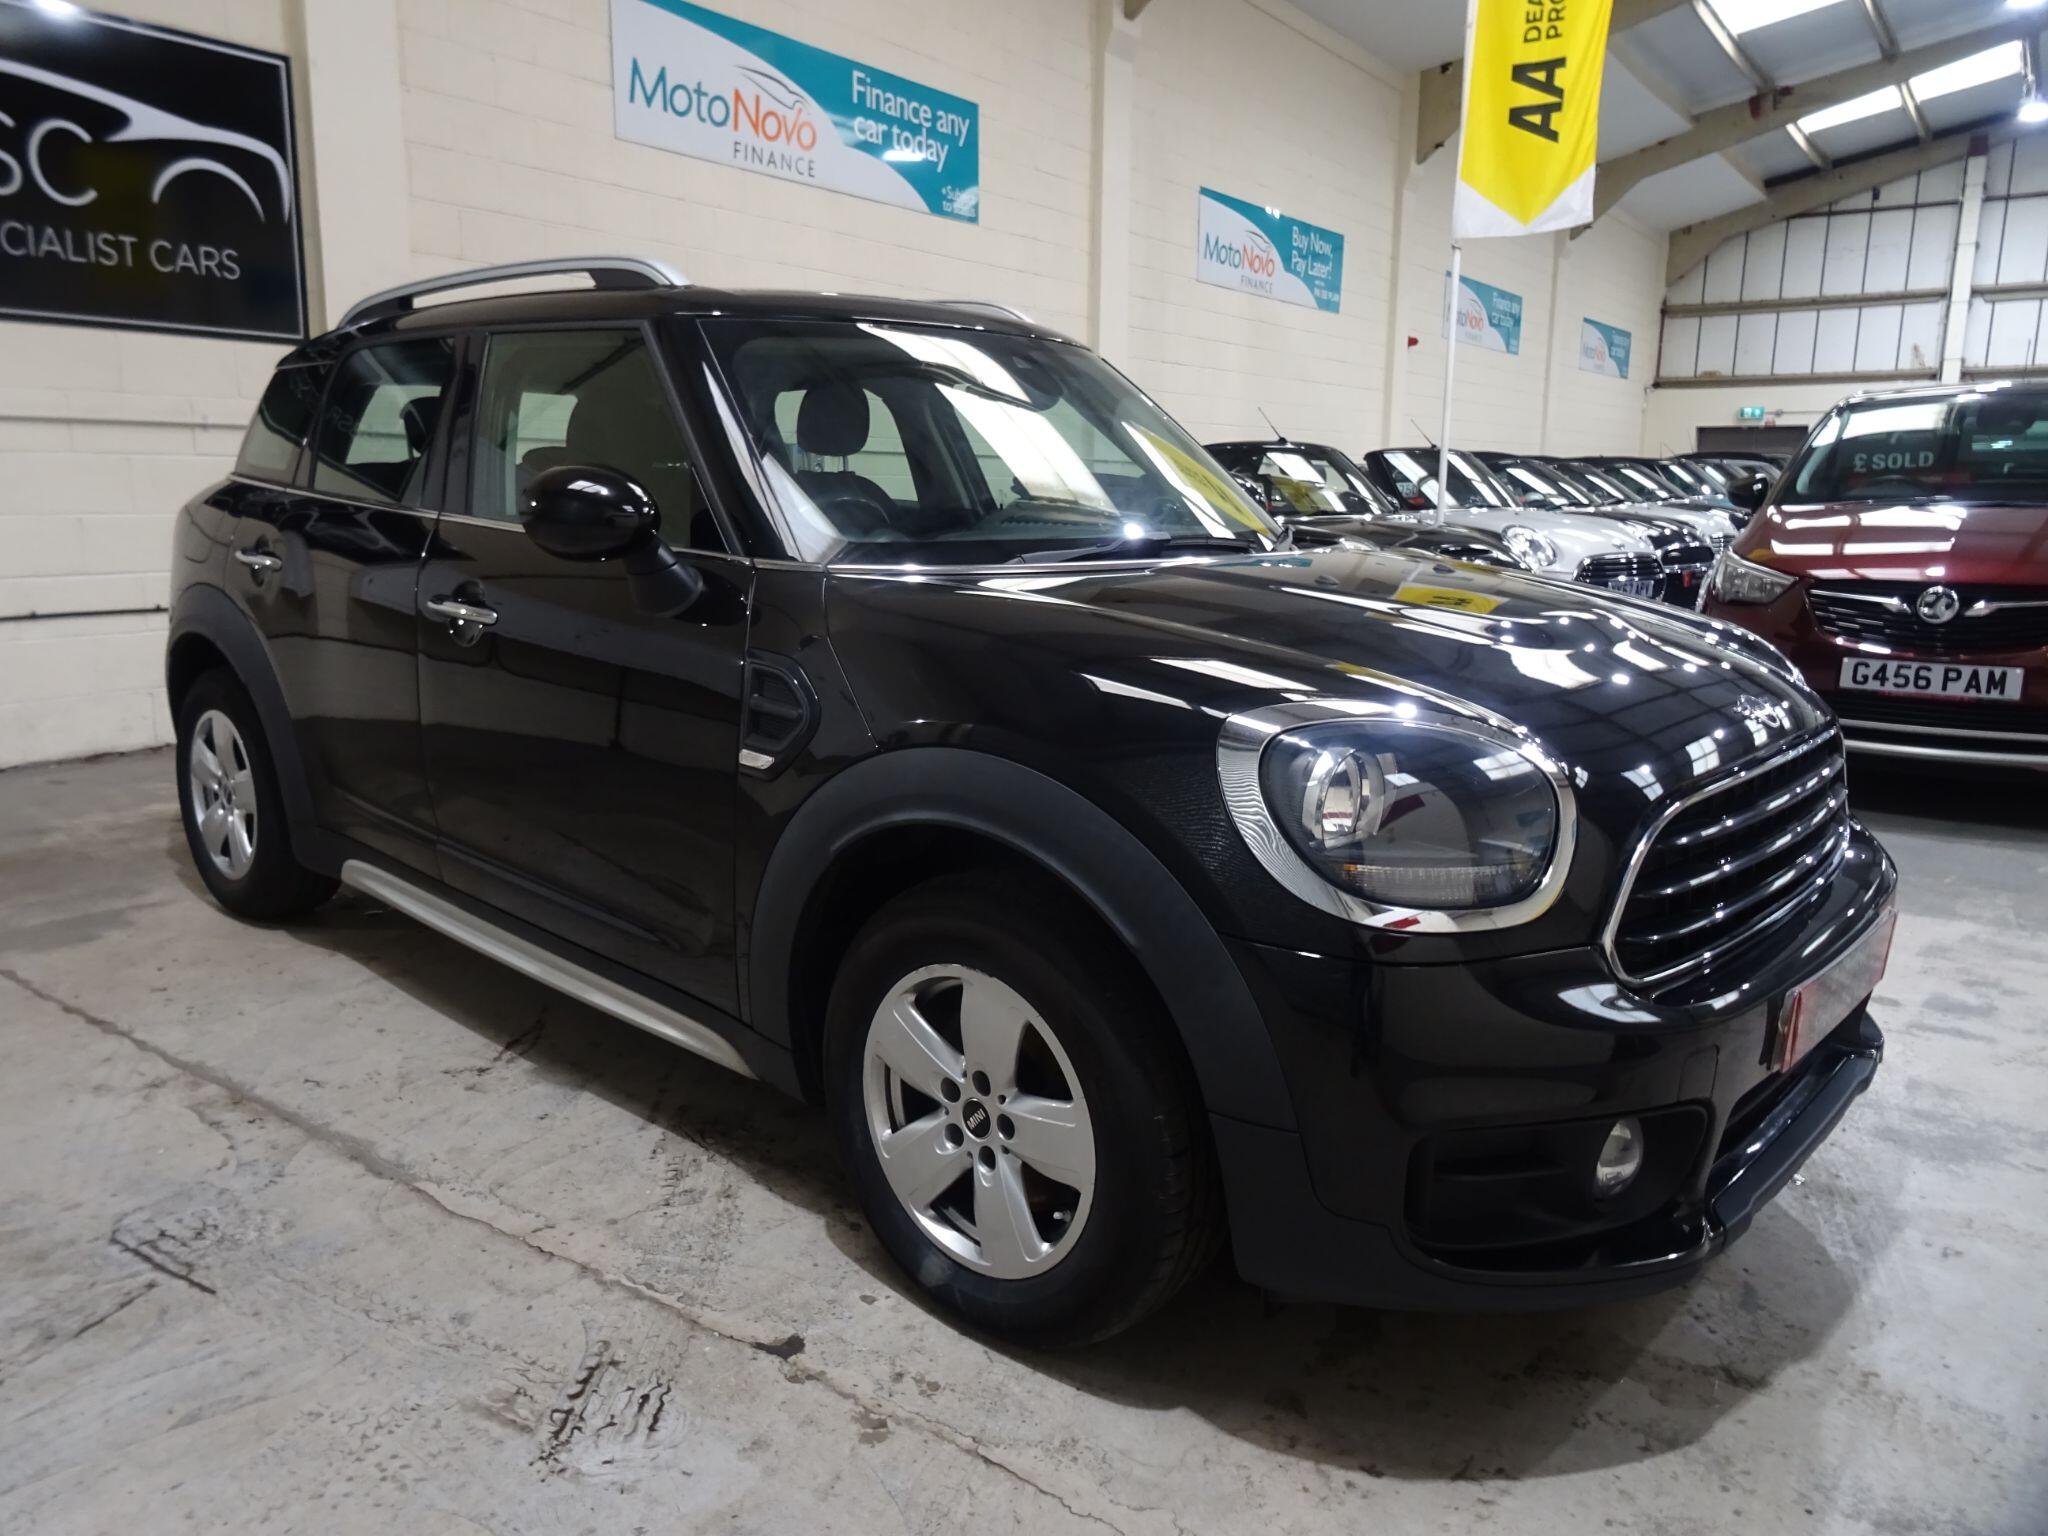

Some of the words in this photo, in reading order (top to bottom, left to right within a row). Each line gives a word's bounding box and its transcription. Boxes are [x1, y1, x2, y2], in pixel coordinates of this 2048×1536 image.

[1546, 0, 1567, 39] PR
[629, 56, 817, 152] MotoNovo
[852, 69, 933, 128] Finance
[936, 110, 970, 147] any
[1508, 56, 1567, 144] AA
[733, 141, 816, 179] FINANCE
[853, 116, 888, 145] car
[891, 123, 950, 173] today
[149, 239, 241, 280] CARS
[1203, 231, 1275, 278] MotoNovo
[1292, 225, 1310, 256] Buy
[1291, 249, 1307, 278] Pay
[1240, 274, 1274, 295] FINANCE
[1871, 451, 1935, 470] SOLD
[1851, 661, 1933, 690] G456
[1941, 666, 2008, 696] PAM
[966, 1108, 987, 1130] MINI
